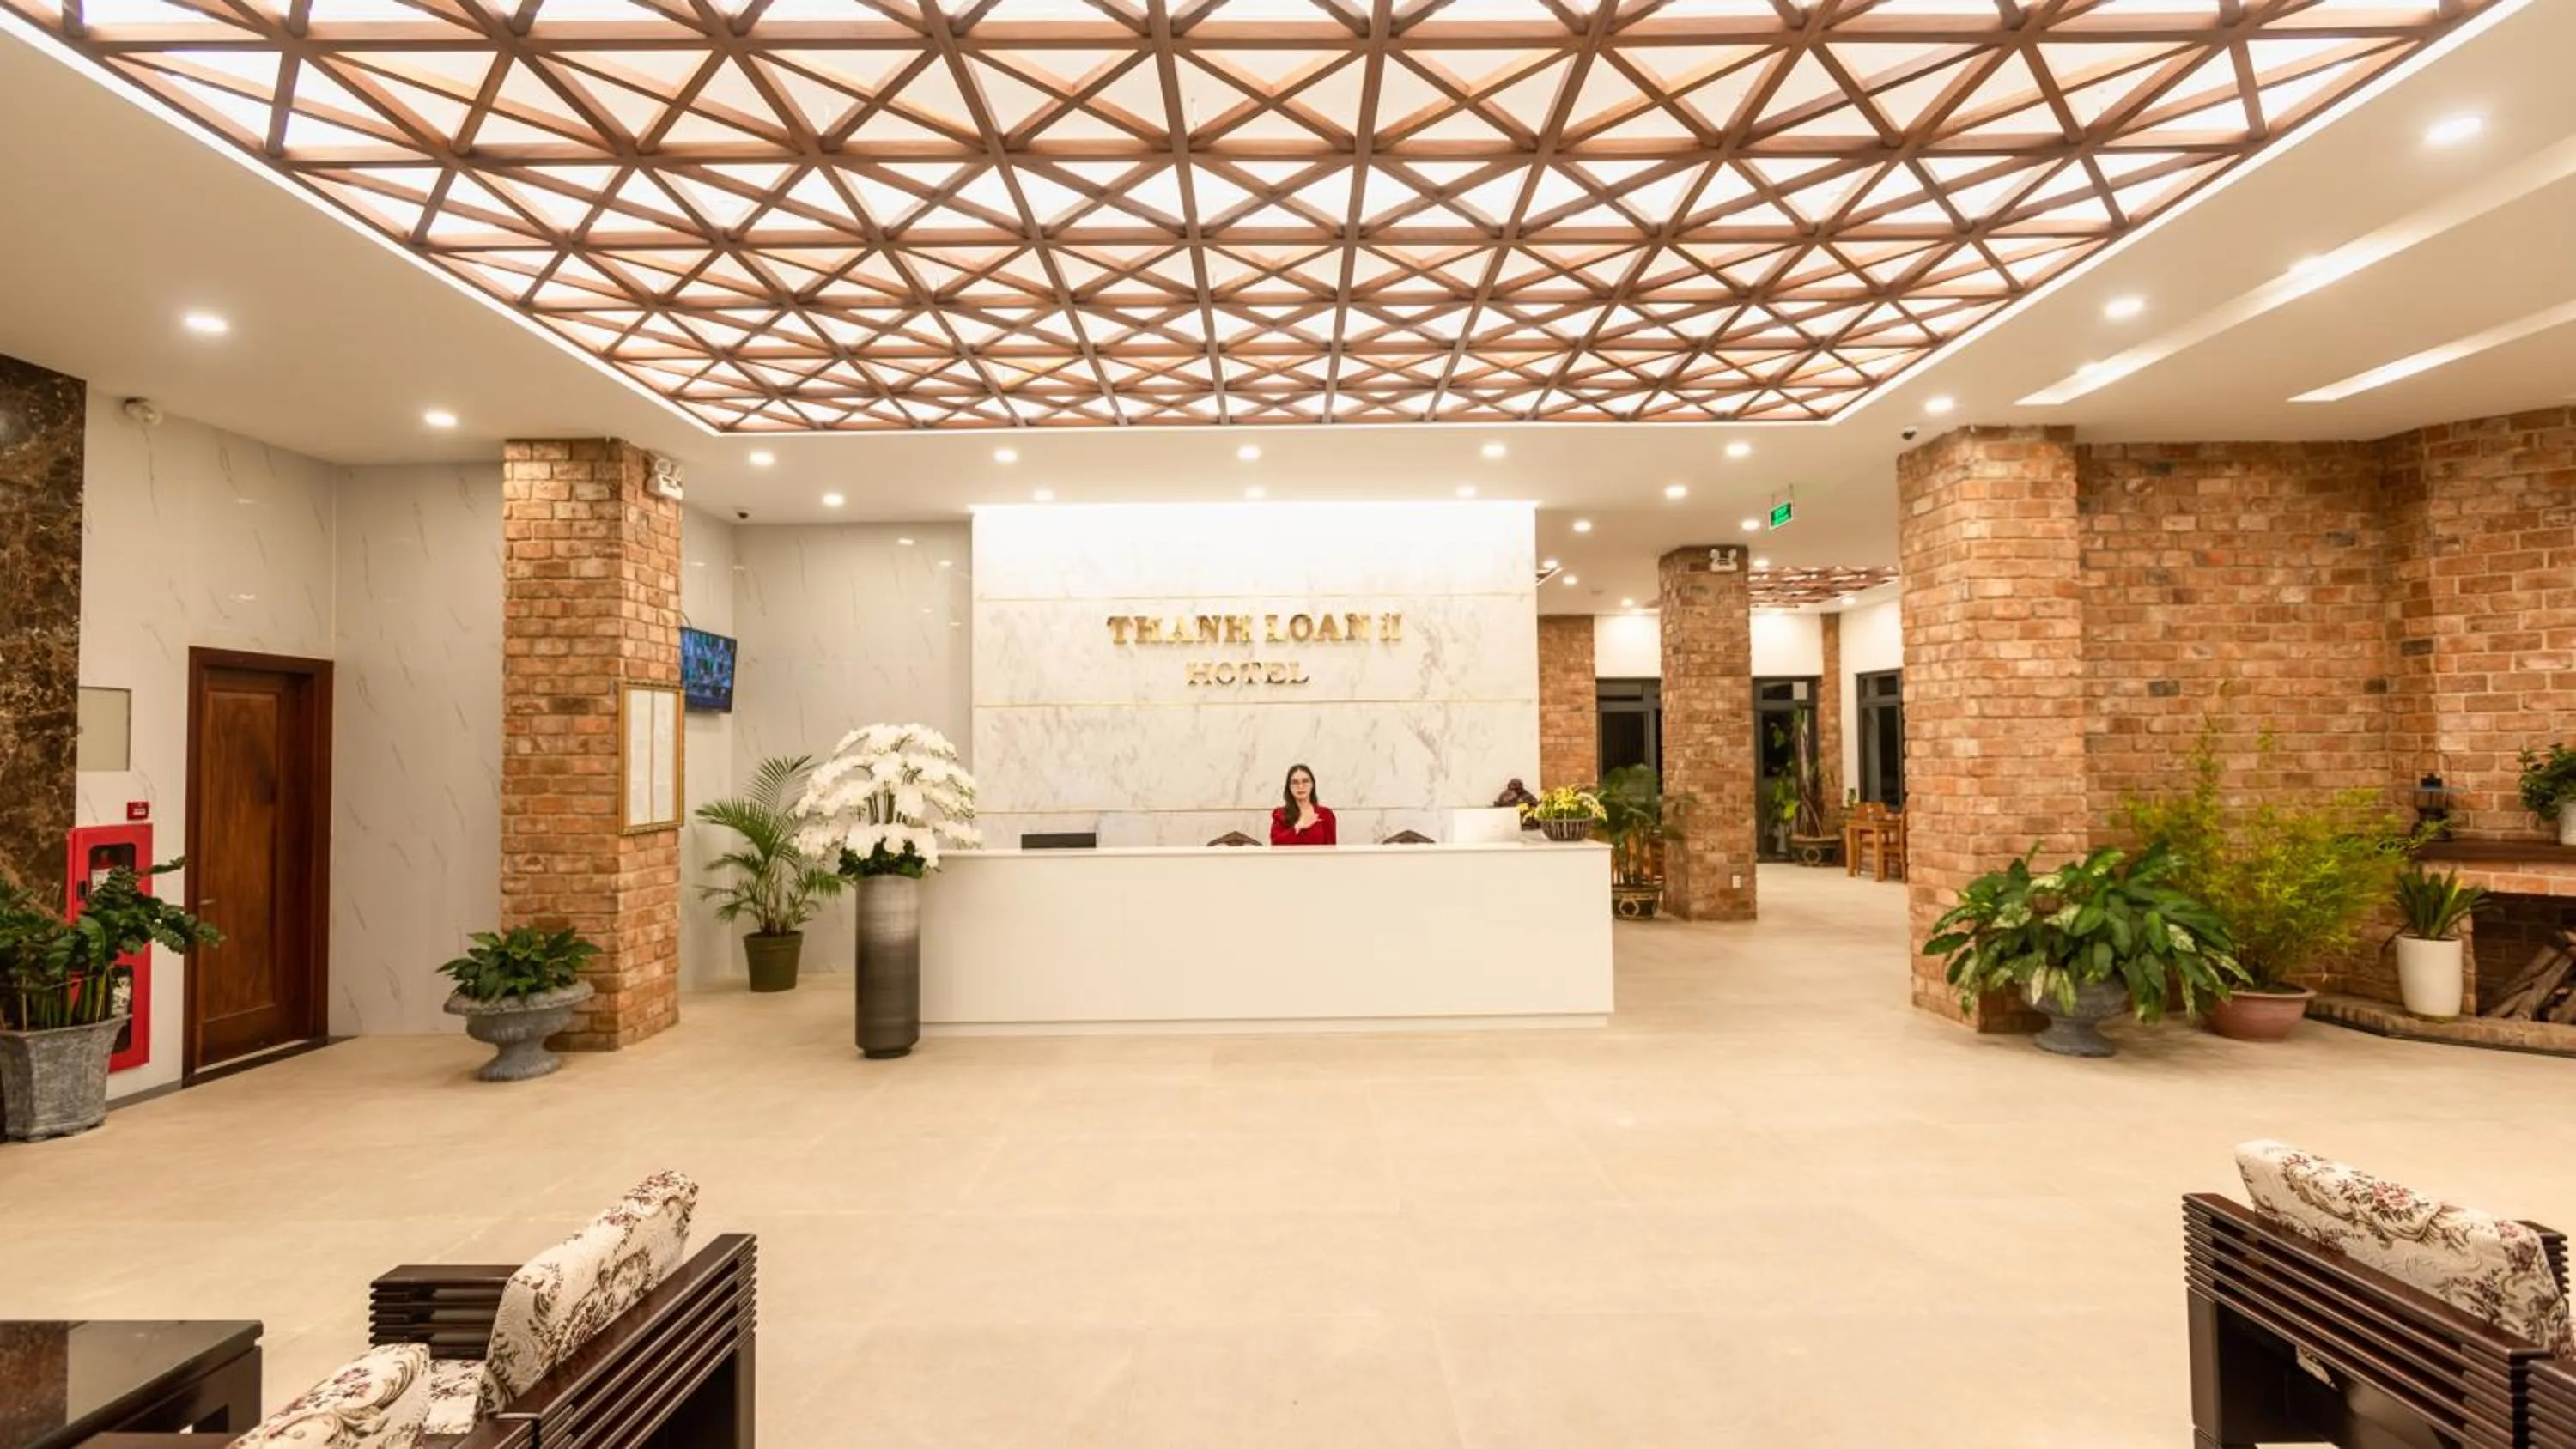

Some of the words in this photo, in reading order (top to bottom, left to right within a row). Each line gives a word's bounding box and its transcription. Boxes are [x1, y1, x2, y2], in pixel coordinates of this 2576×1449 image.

[1107, 615, 1254, 645] THANH
[1264, 613, 1371, 642] LOAN
[1185, 662, 1310, 686] HOTEL
